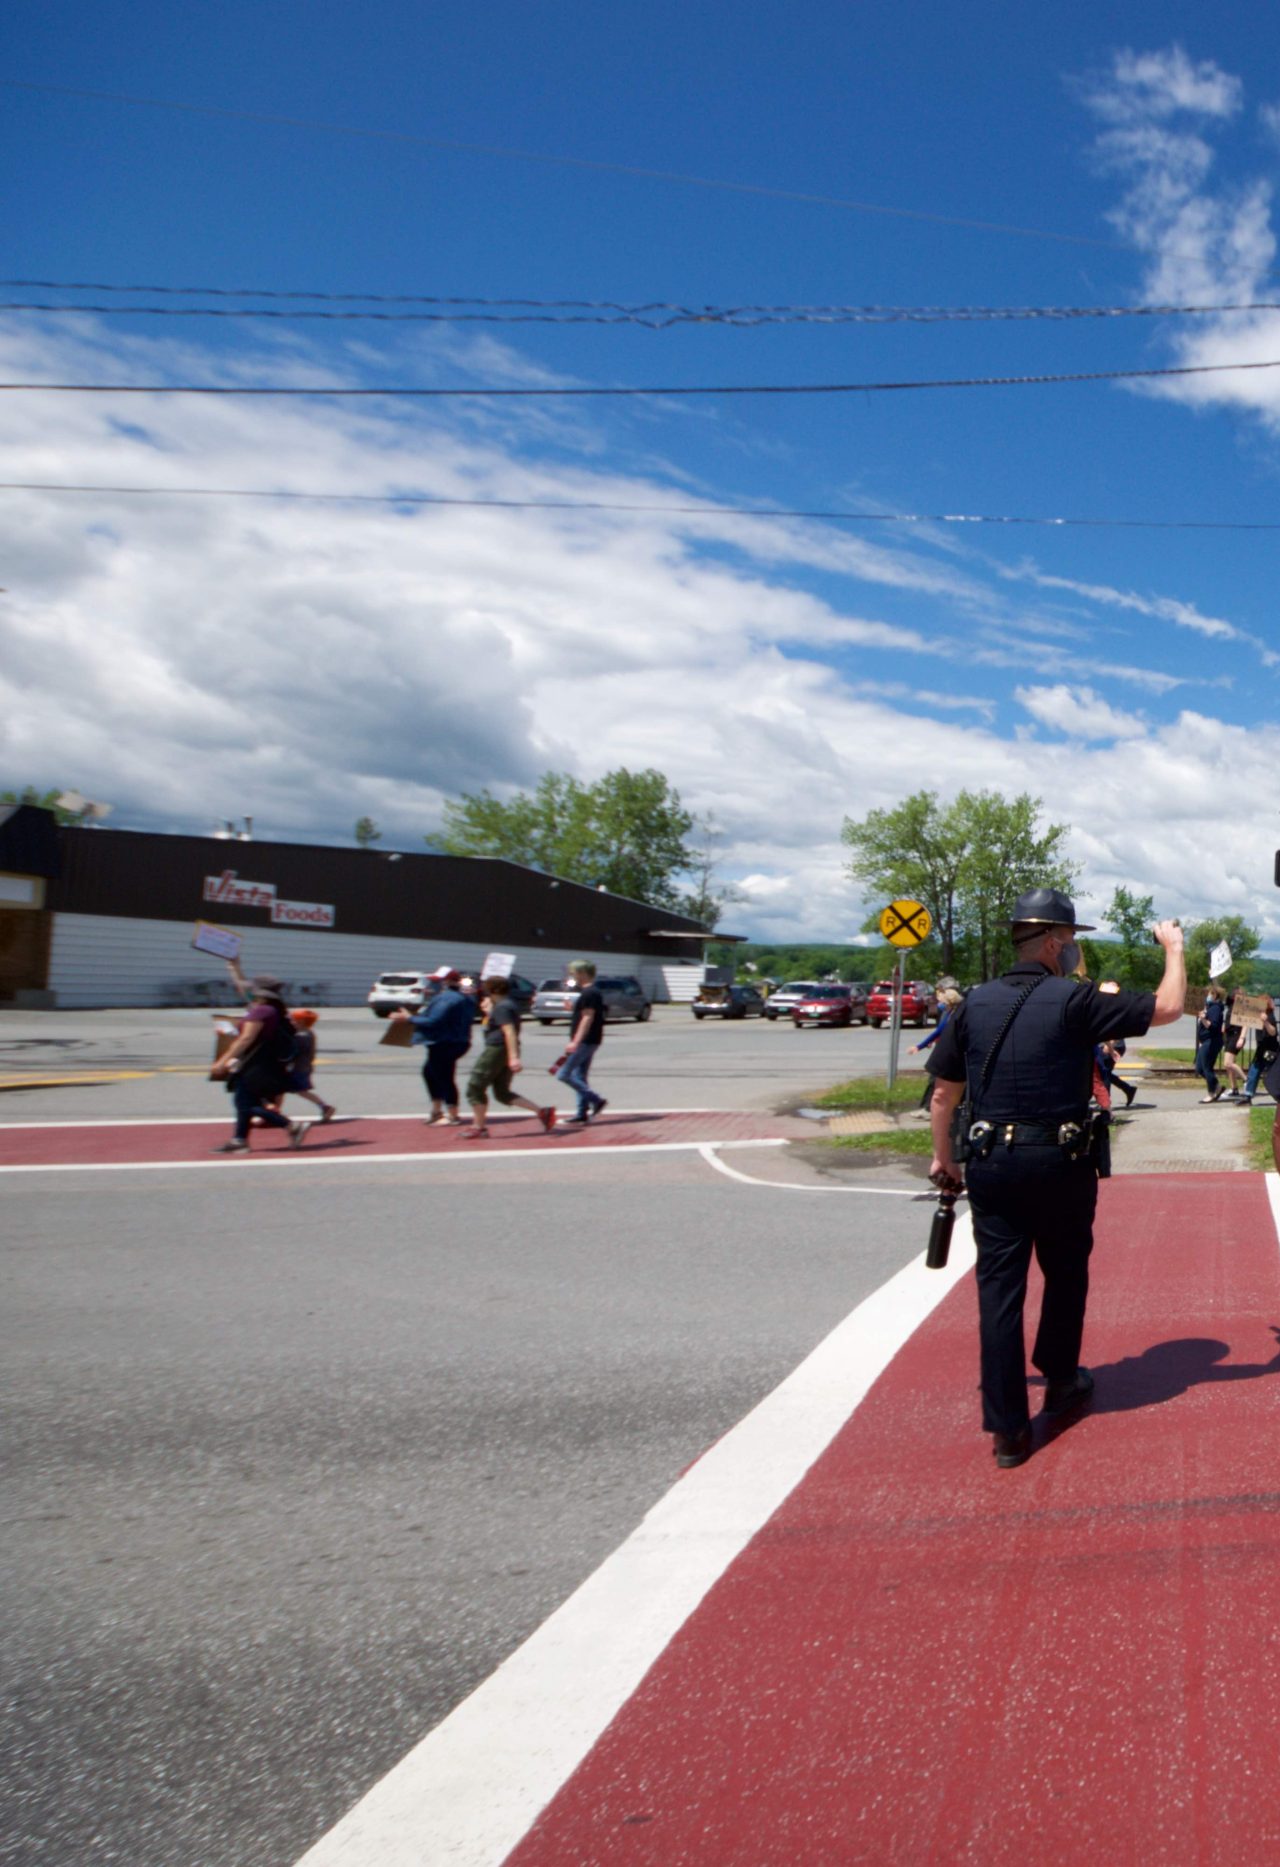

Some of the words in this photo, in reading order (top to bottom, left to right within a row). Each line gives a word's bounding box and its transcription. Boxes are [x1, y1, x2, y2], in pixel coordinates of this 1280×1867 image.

[274, 902, 330, 923] Foods
[886, 916, 896, 928] R
[917, 918, 927, 930] R
